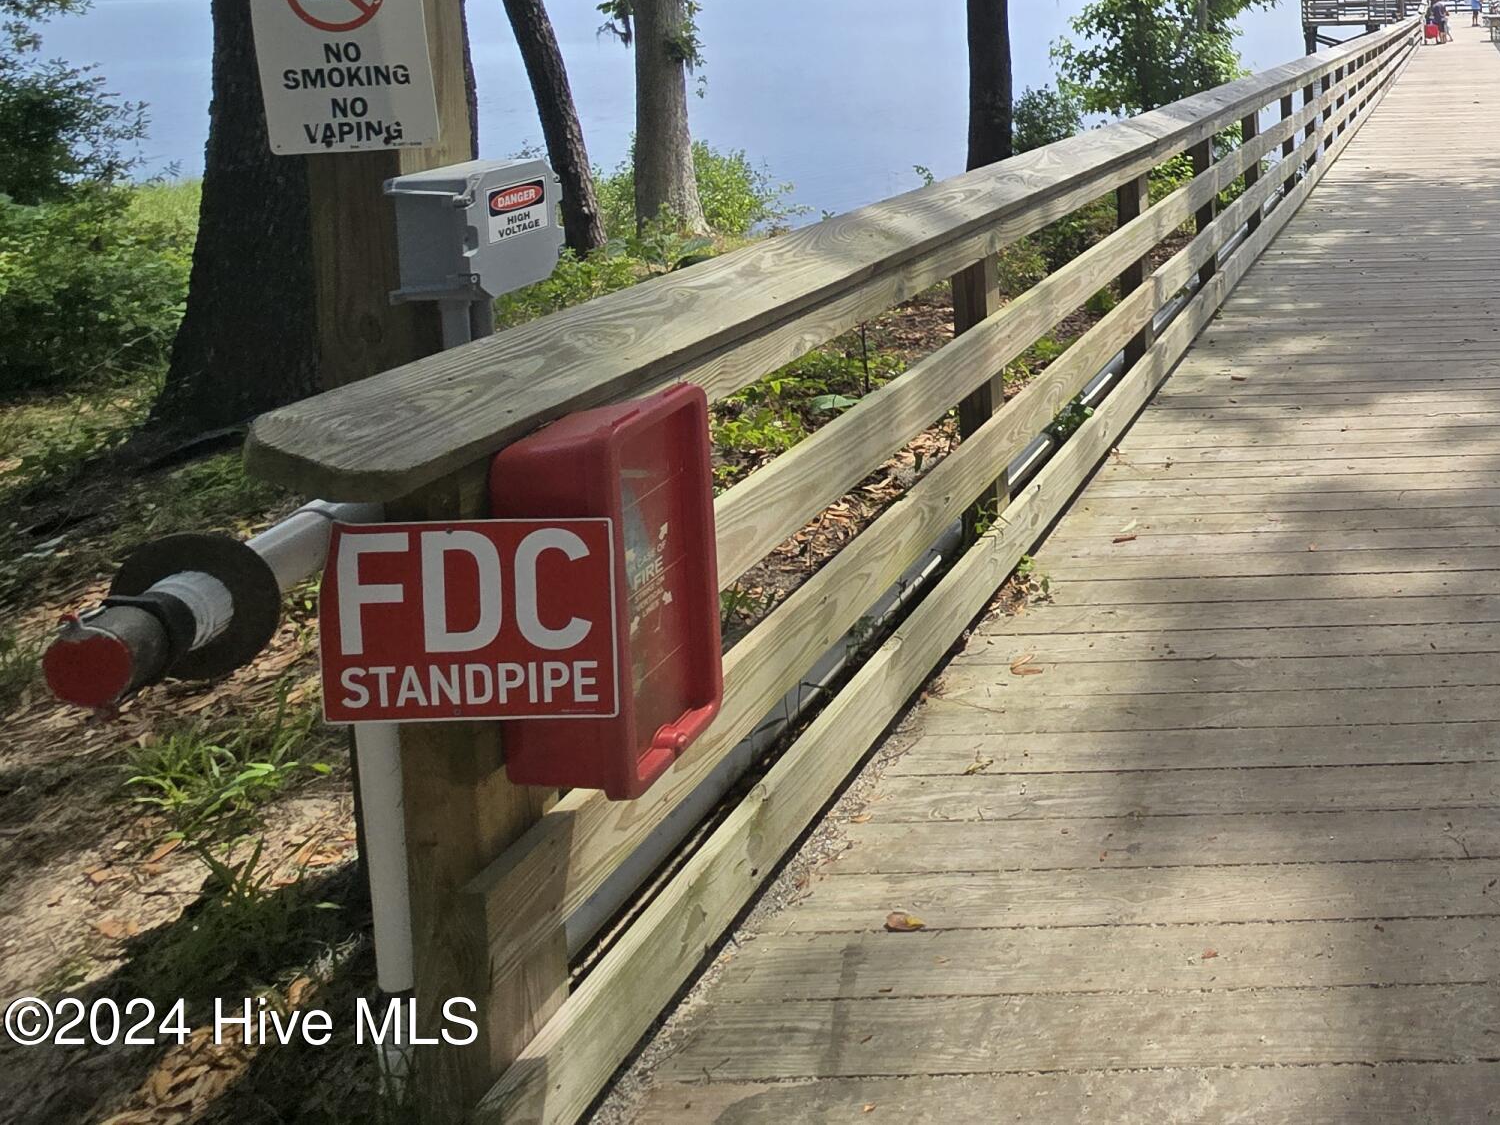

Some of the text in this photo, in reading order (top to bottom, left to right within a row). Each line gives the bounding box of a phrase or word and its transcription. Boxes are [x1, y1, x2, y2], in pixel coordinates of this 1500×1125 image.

[323, 41, 362, 64] NO
[283, 64, 411, 90] SMOKING
[331, 97, 369, 118] NO
[303, 120, 403, 144] VAPING
[497, 188, 536, 208] DANGER
[498, 218, 541, 238] VOLTAGE
[507, 211, 531, 225] HIGH
[633, 555, 665, 591] FIRE
[337, 527, 593, 655] FDC
[340, 660, 599, 709] STANDPIPE
